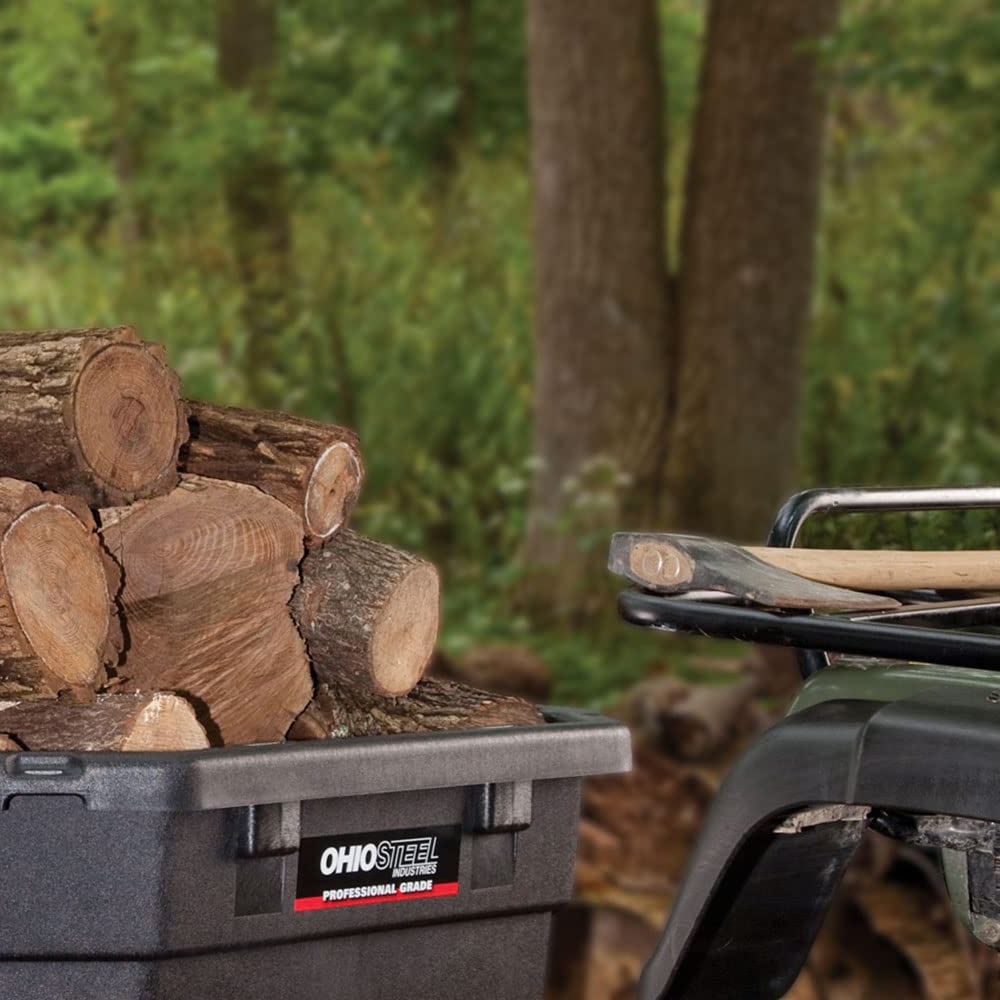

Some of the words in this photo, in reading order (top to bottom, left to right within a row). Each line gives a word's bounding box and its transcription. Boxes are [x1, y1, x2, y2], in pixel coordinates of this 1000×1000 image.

[392, 865, 437, 878] INDUSTRIES
[322, 883, 397, 902] PROFESSIONAL
[399, 880, 433, 893] GRADE
